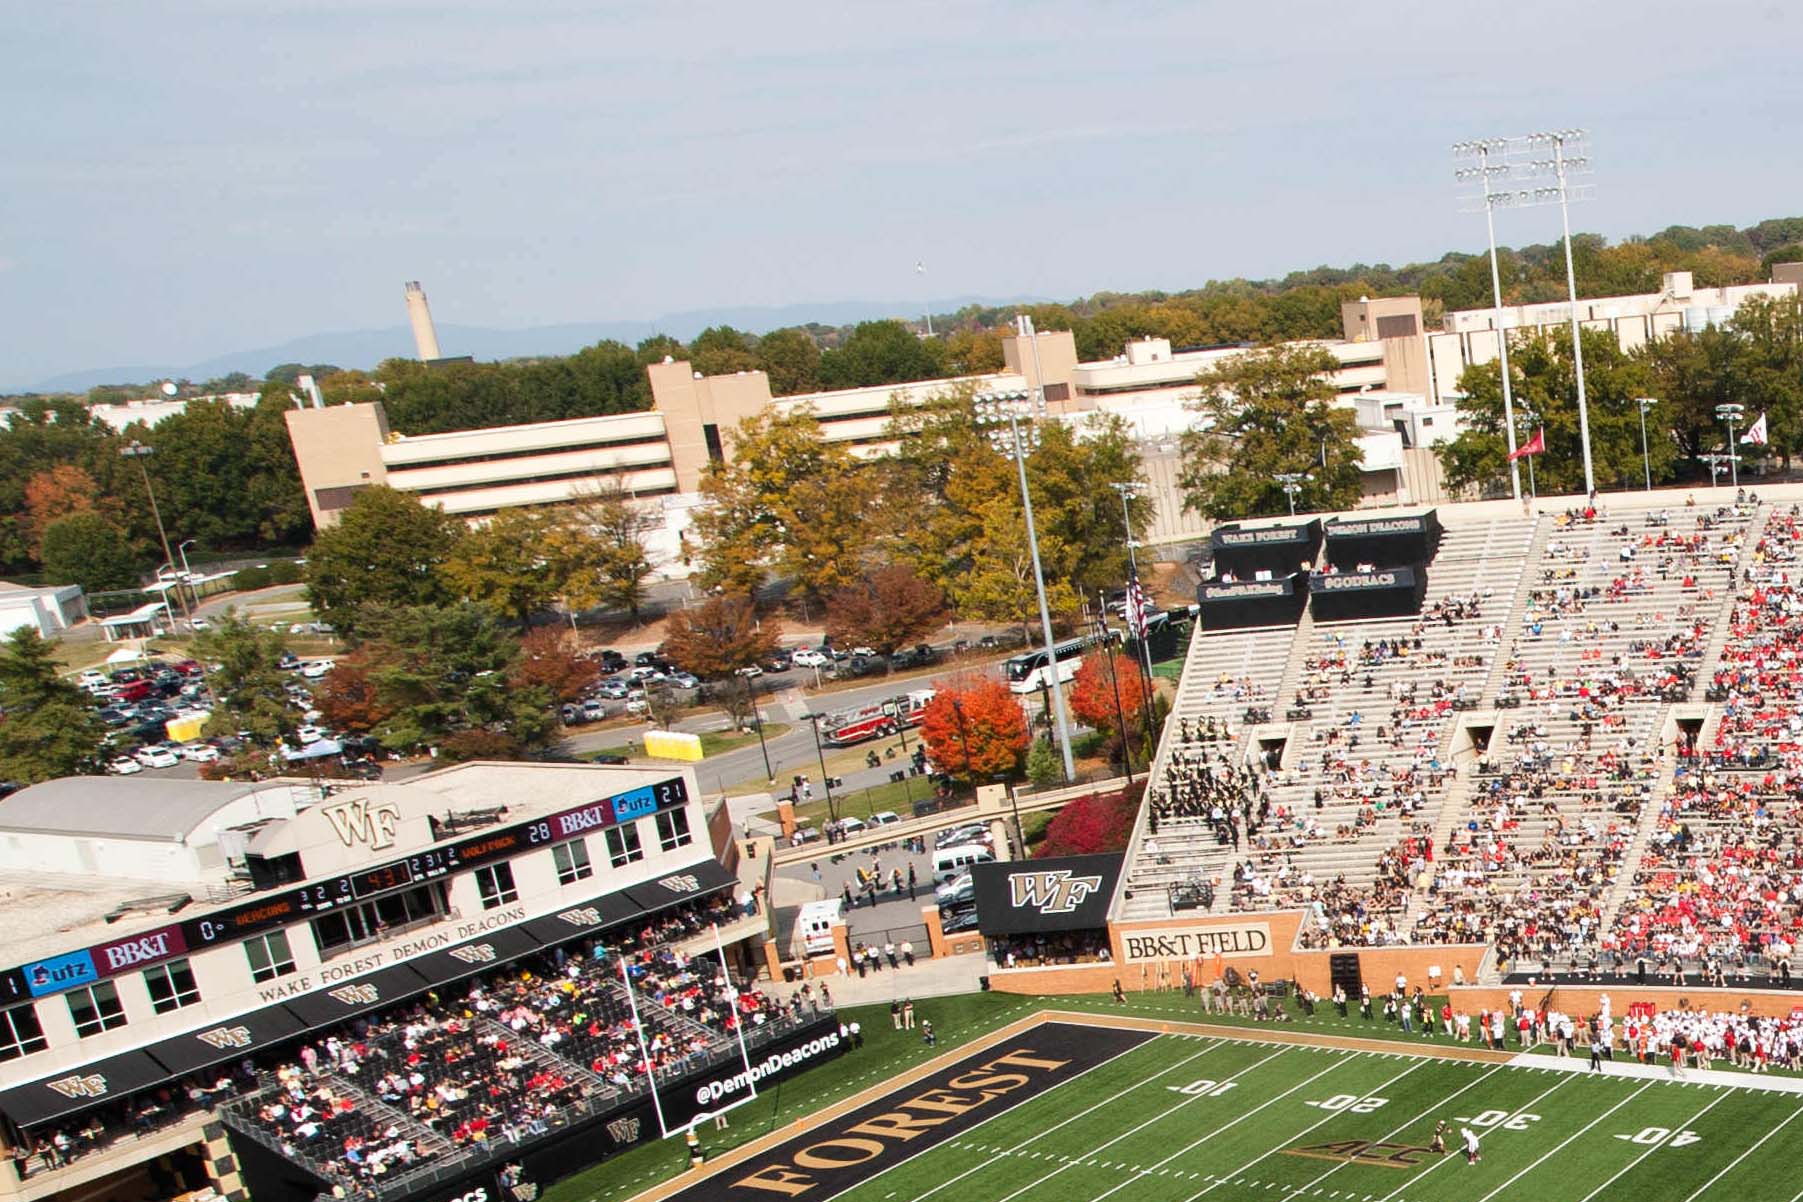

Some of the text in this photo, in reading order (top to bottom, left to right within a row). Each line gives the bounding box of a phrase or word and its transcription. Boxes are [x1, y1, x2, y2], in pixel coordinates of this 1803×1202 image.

[321, 797, 400, 851] WF
[529, 822, 550, 844] 28
[560, 806, 603, 835] BB&T
[1008, 869, 1103, 914] WF
[105, 932, 168, 970] BB&T
[259, 908, 526, 1004] WAKE FOREST DEMON DEACONS
[1127, 930, 1266, 959] BB&T FIELD
[697, 1031, 839, 1104] @DemonDeacons
[47, 1074, 108, 1099] WF
[607, 1116, 640, 1143] WF
[729, 1049, 1073, 1197] FOREST
[1300, 1140, 1434, 1164] ACC
